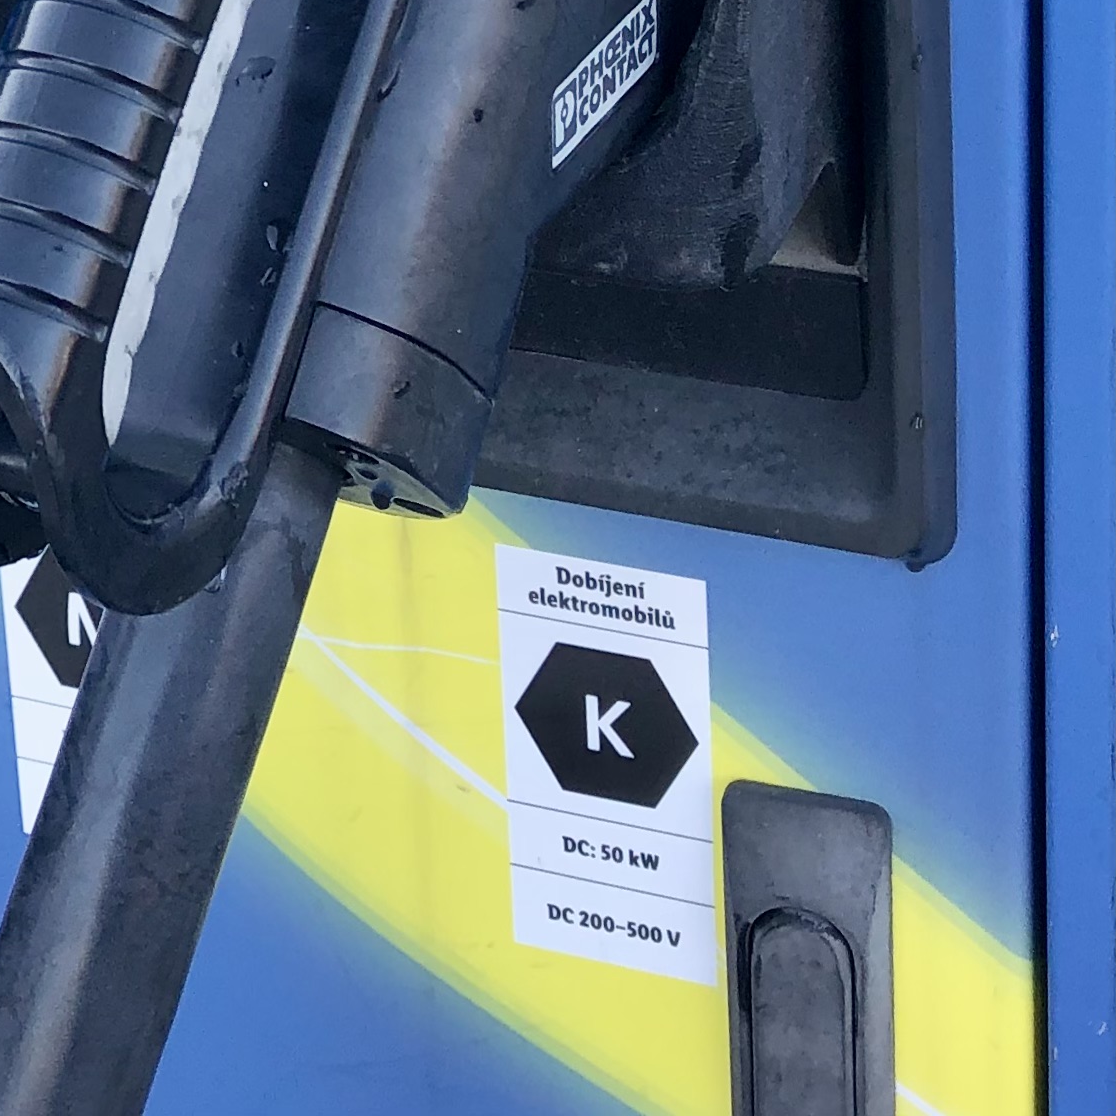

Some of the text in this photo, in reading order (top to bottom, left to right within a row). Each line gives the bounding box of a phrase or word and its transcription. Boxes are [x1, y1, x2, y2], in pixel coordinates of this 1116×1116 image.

[578, 27, 655, 126] CONTACT
[555, 566, 646, 600] Dobíjení
[528, 587, 676, 630] elektromobilů
[584, 693, 635, 760] K
[562, 835, 660, 871] DC: 50 kW
[546, 903, 575, 924] DC
[666, 929, 681, 947] V
